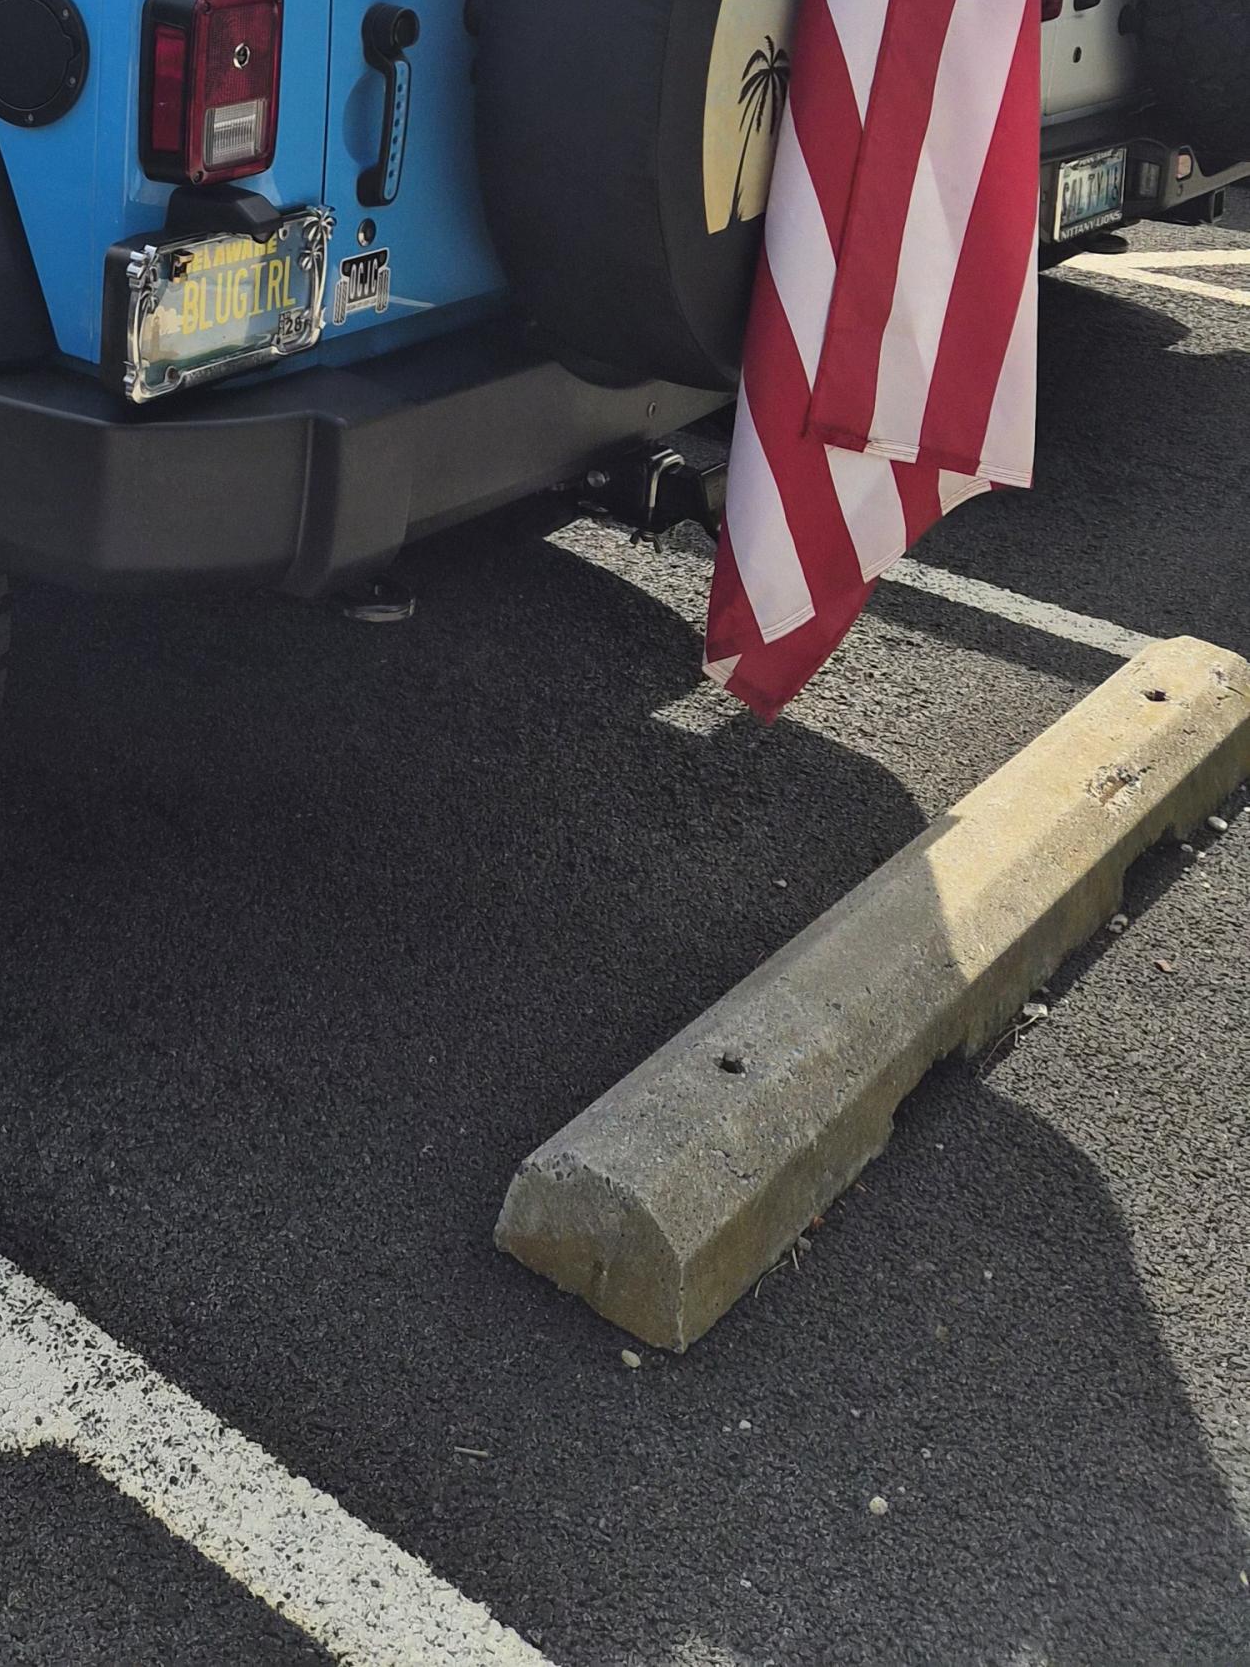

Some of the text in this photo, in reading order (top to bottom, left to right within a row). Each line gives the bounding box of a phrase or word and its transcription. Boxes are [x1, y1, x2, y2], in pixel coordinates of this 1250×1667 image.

[1061, 211, 1123, 240] NITTANY LIONS
[182, 255, 296, 334] BLUGIRL
[350, 258, 378, 300] OCJC
[286, 316, 302, 335] 28
